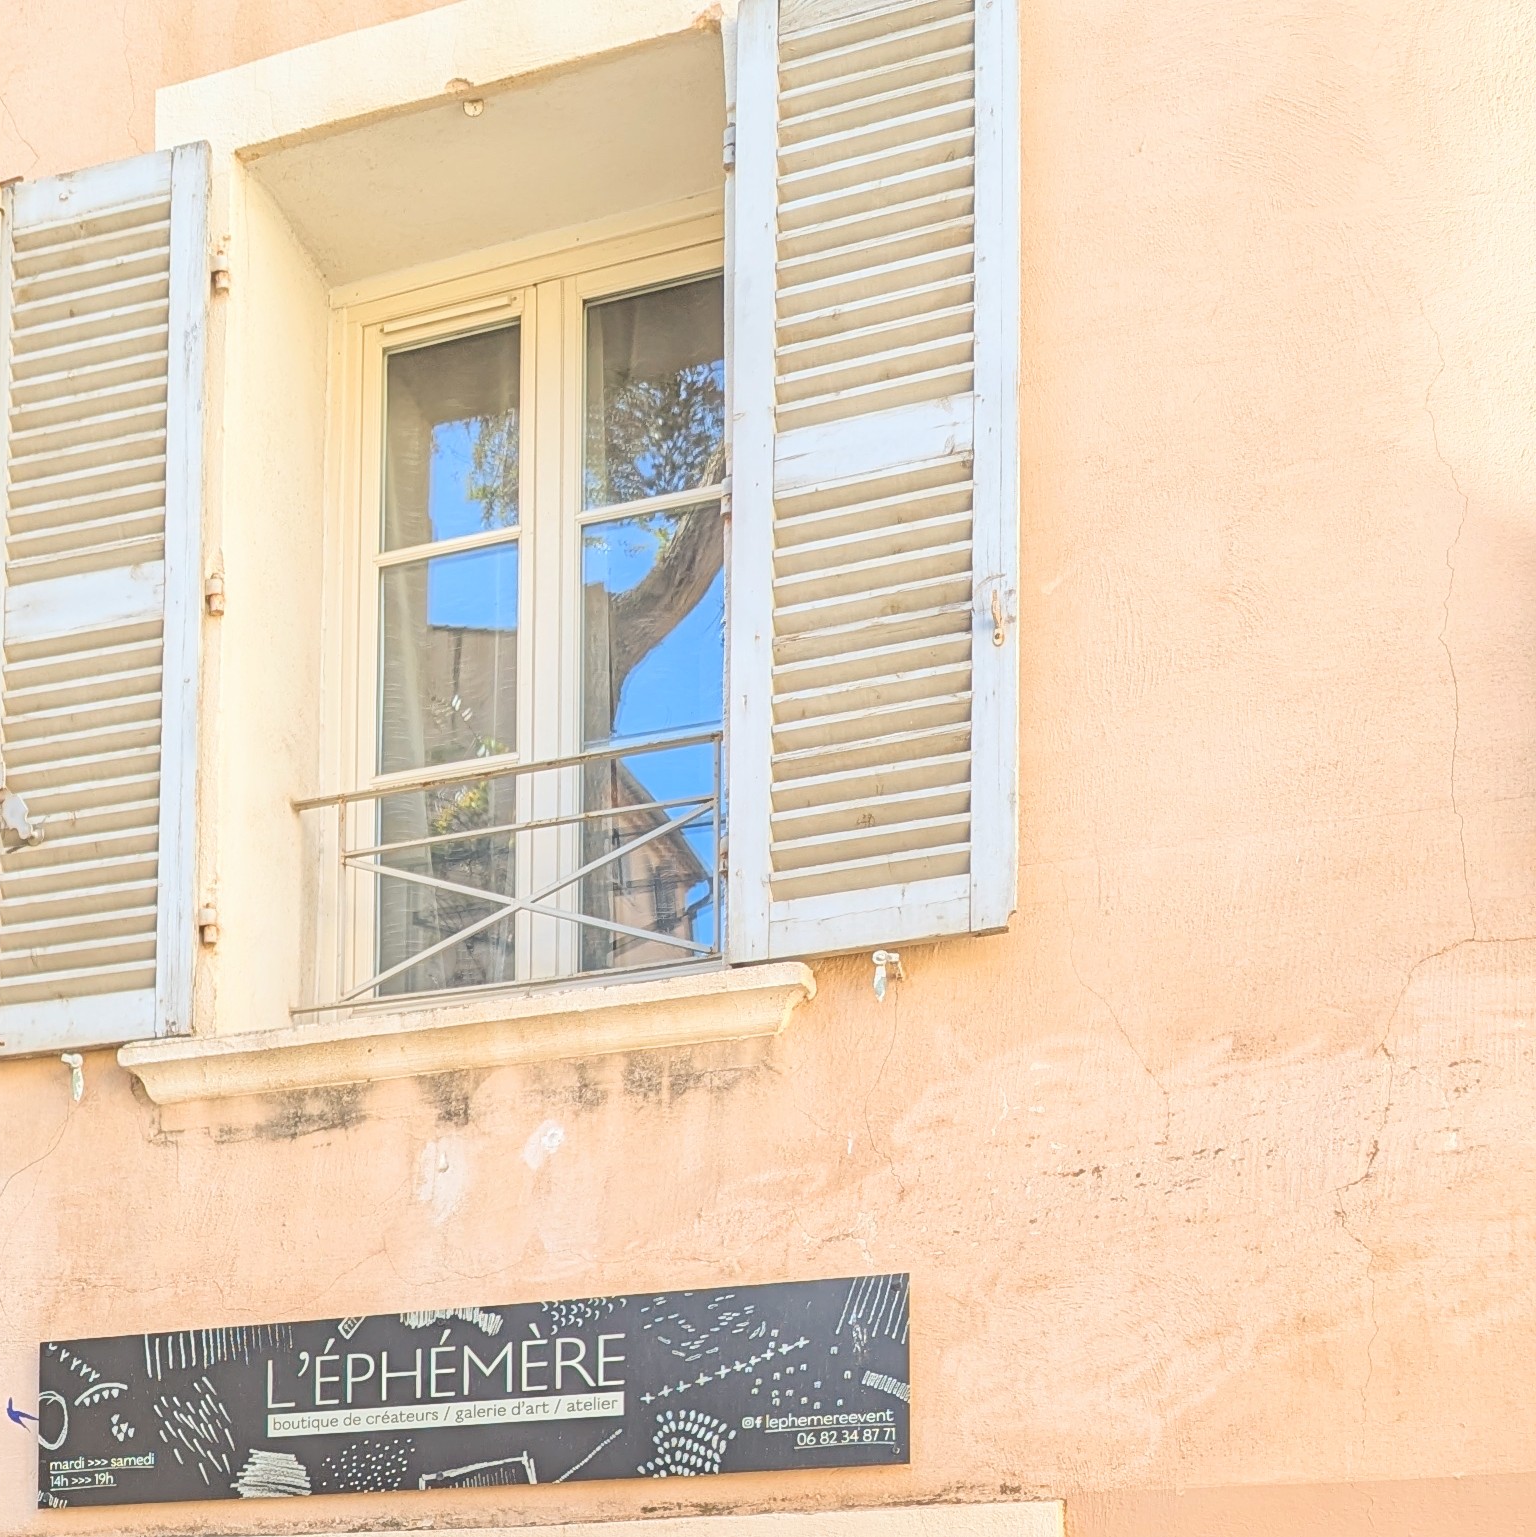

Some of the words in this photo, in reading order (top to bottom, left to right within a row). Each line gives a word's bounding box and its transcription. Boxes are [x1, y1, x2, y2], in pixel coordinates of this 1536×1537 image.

[267, 1322, 626, 1409] L'ÉPHÉMÈRE
[273, 1415, 339, 1431] boutique
[343, 1412, 362, 1426] de
[365, 1410, 439, 1425] créateurs
[454, 1404, 507, 1423] galerie
[511, 1400, 550, 1416] d'art
[566, 1396, 618, 1413] atelier
[766, 1408, 895, 1430] lephemereevent
[796, 1432, 816, 1446] 06
[819, 1430, 838, 1445] 82
[841, 1429, 860, 1443] 34
[862, 1428, 879, 1442] 87
[883, 1427, 897, 1441] 71
[50, 1456, 85, 1471] mardi
[110, 1452, 155, 1467] samedi
[49, 1475, 69, 1488] 14h
[94, 1471, 114, 1485] 19h
